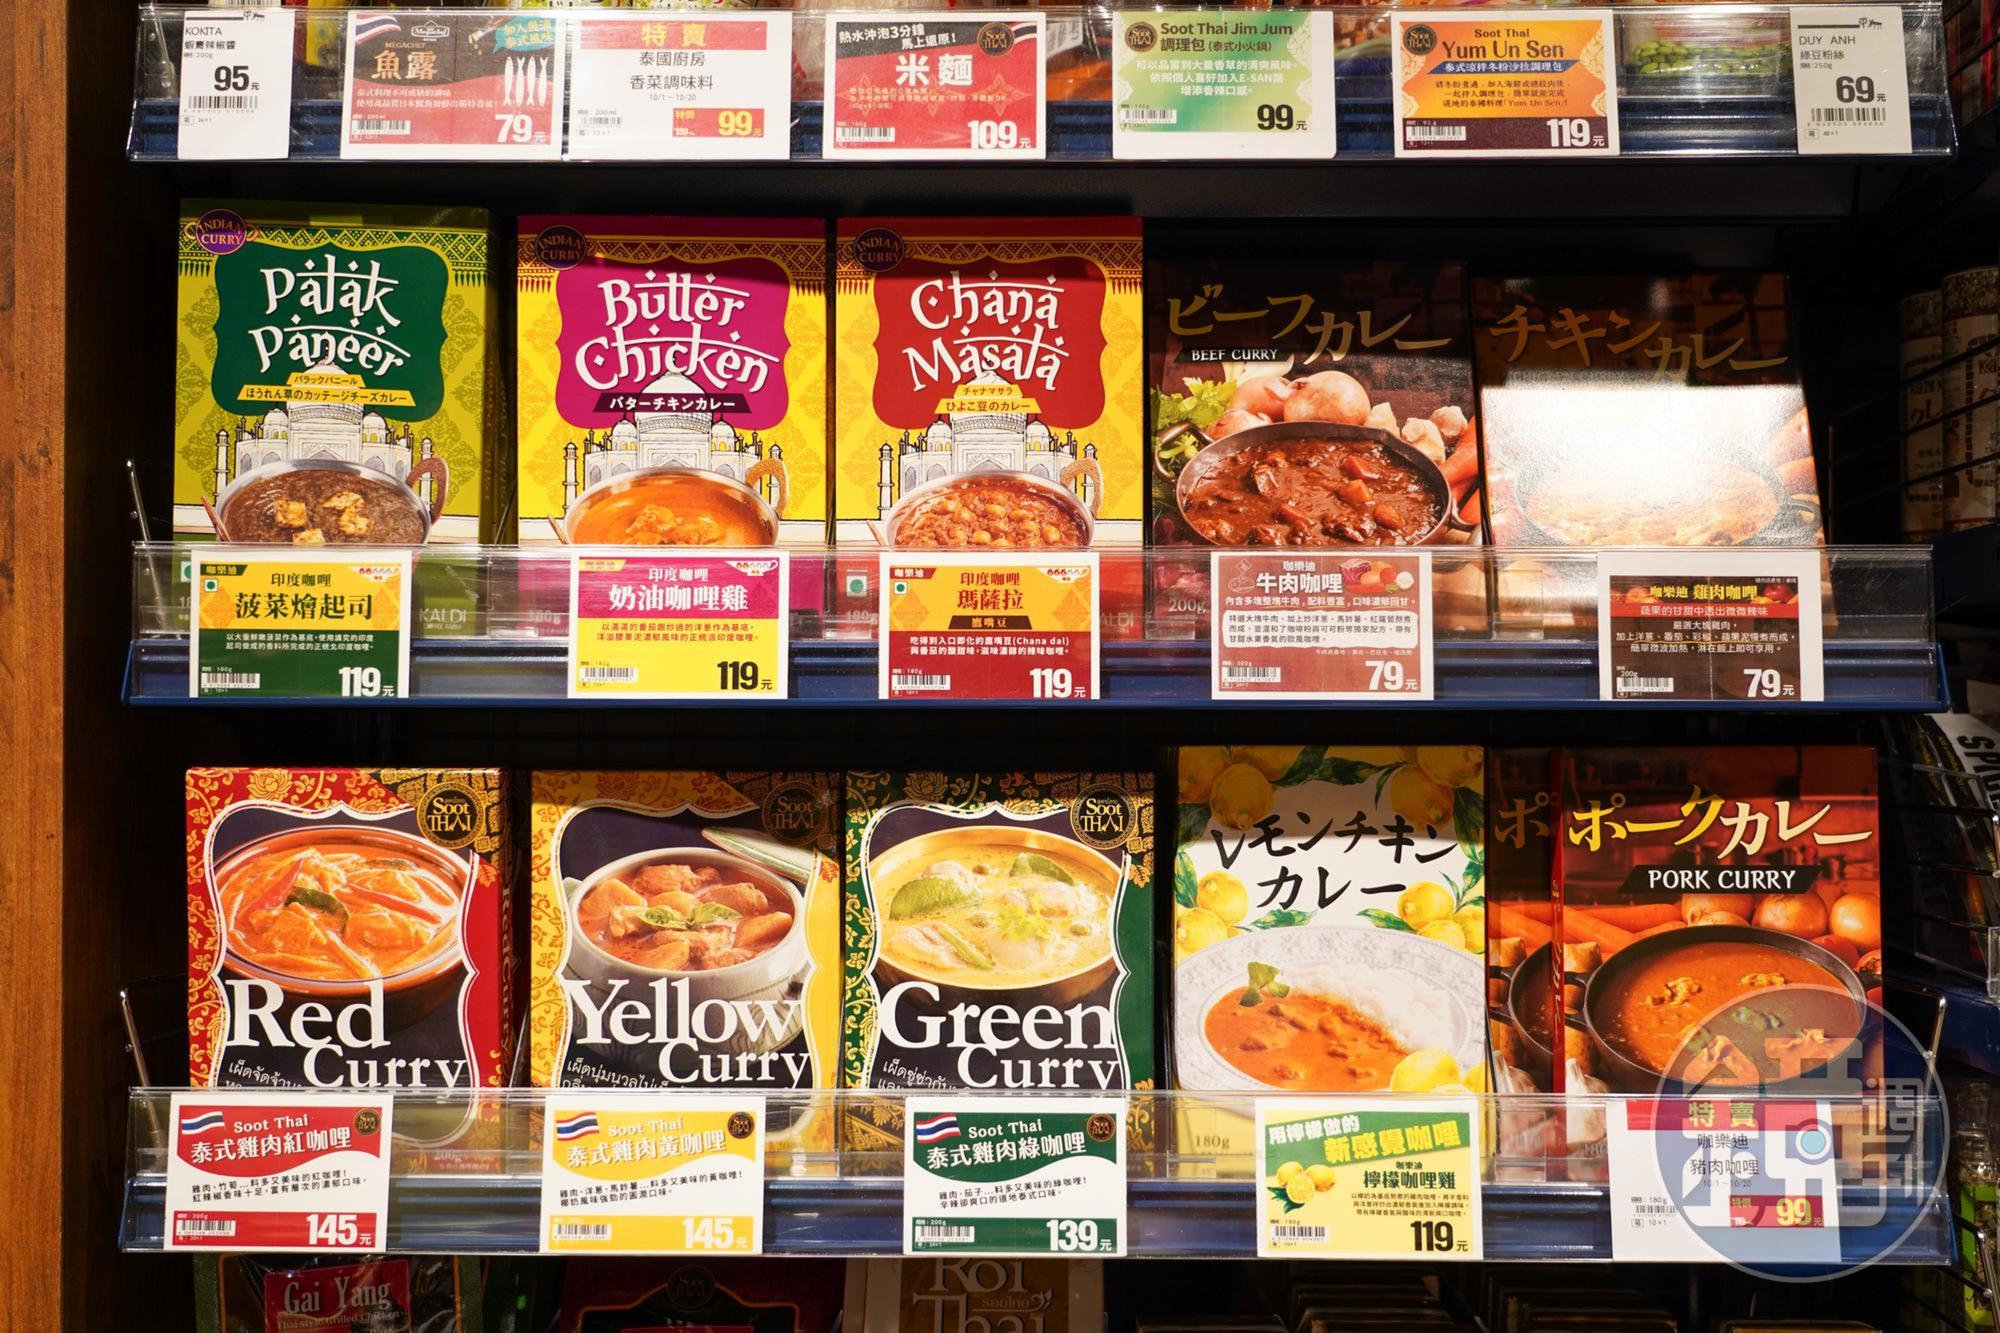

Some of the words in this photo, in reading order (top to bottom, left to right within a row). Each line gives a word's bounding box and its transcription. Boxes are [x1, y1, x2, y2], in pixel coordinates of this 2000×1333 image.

[184, 26, 222, 36] KOKITA
[642, 23, 706, 47] 特賣
[839, 24, 925, 44] 熱水沖泡3分鐘
[1161, 23, 1194, 35] Soot
[1197, 23, 1228, 35] Thai
[1230, 23, 1258, 35] Jim
[1261, 23, 1293, 35] Jum
[1474, 29, 1501, 37] Soot
[1505, 29, 1530, 37] Thai
[1161, 38, 1204, 52] 調理包
[1442, 41, 1487, 58] Yum
[1493, 41, 1520, 58] Un
[1526, 41, 1564, 57] Sen
[1799, 35, 1822, 45] DUY
[1831, 35, 1856, 45] ANH
[640, 52, 705, 66] 泰國廚房
[1800, 50, 1845, 60] 綠豆粉絲
[371, 50, 438, 80] 魚露
[896, 54, 972, 86] 米麵
[630, 75, 713, 90] 香菜調味料
[199, 217, 244, 236] INDIA
[202, 233, 242, 245] CURRY
[260, 254, 400, 326] Palak
[598, 270, 750, 327] Butter
[910, 271, 1064, 330] Chana
[1168, 284, 1452, 366] ビーフカレー
[248, 315, 411, 377] Paneer
[1490, 305, 1789, 381] チキンカレー
[575, 321, 780, 393] Chicken
[902, 323, 1069, 392] Masala
[1192, 350, 1225, 361] BEEF
[1232, 349, 1279, 360] CURRY
[246, 388, 407, 404] ほうれん草のカッテージチーズカレー
[962, 386, 1013, 396] チャナマサラ
[609, 396, 736, 410] バターチキンカレー
[946, 400, 1030, 412] ひよこ豆のカレー
[271, 573, 331, 587] 印度咖哩
[648, 568, 708, 582] 印度咖哩
[960, 572, 1020, 586] 印度咖哩
[1257, 573, 1343, 594] 牛肉咖哩
[609, 584, 749, 611] 奶油咖哩雞
[957, 589, 1024, 610] 瑪薩拉
[1693, 584, 1758, 600] 雞肉咖哩
[235, 592, 373, 620] 菠菜燴起司
[420, 608, 467, 623] KALDI
[1169, 599, 1206, 615] 200g
[432, 797, 470, 815] Soot
[1086, 798, 1121, 815] Soot
[426, 815, 472, 831] THAI
[1080, 815, 1123, 831] THAI
[1569, 785, 1872, 860] ポークカレー
[1211, 811, 1457, 870] レモンチキン
[1256, 865, 1406, 911] カレー
[1648, 870, 1710, 889] PORK
[1718, 870, 1796, 889] CURRY
[226, 977, 391, 1049] Red
[567, 976, 802, 1045] Yellow
[879, 981, 1117, 1049] Green
[303, 1044, 467, 1097] Curry
[659, 1040, 811, 1088] Curry
[958, 1044, 1121, 1094] Curry
[234, 1120, 268, 1133] Soot
[274, 1114, 309, 1128] Thai
[1688, 1101, 1756, 1128] 特賣
[608, 1123, 644, 1136] Soot
[649, 1119, 684, 1132] Thai
[969, 1126, 1003, 1138] Soot
[1008, 1119, 1042, 1133] Thai
[1269, 1115, 1360, 1144] 用檸檬做的
[191, 1127, 352, 1164] 泰式雞肉紅咖哩
[567, 1130, 728, 1167] 泰式雞肉黃咖哩
[927, 1132, 1086, 1169] 泰式雞肉綠咖哩
[1196, 1136, 1230, 1150] 180g
[1324, 1120, 1460, 1163] 新感覺咖哩
[1697, 1133, 1748, 1149] 咖樂迪
[1689, 1159, 1760, 1176] 豬肉咖哩
[1363, 1170, 1456, 1189] 檸檬咖哩雞
[284, 1281, 321, 1314] Gai
[335, 1276, 393, 1310] Yang
